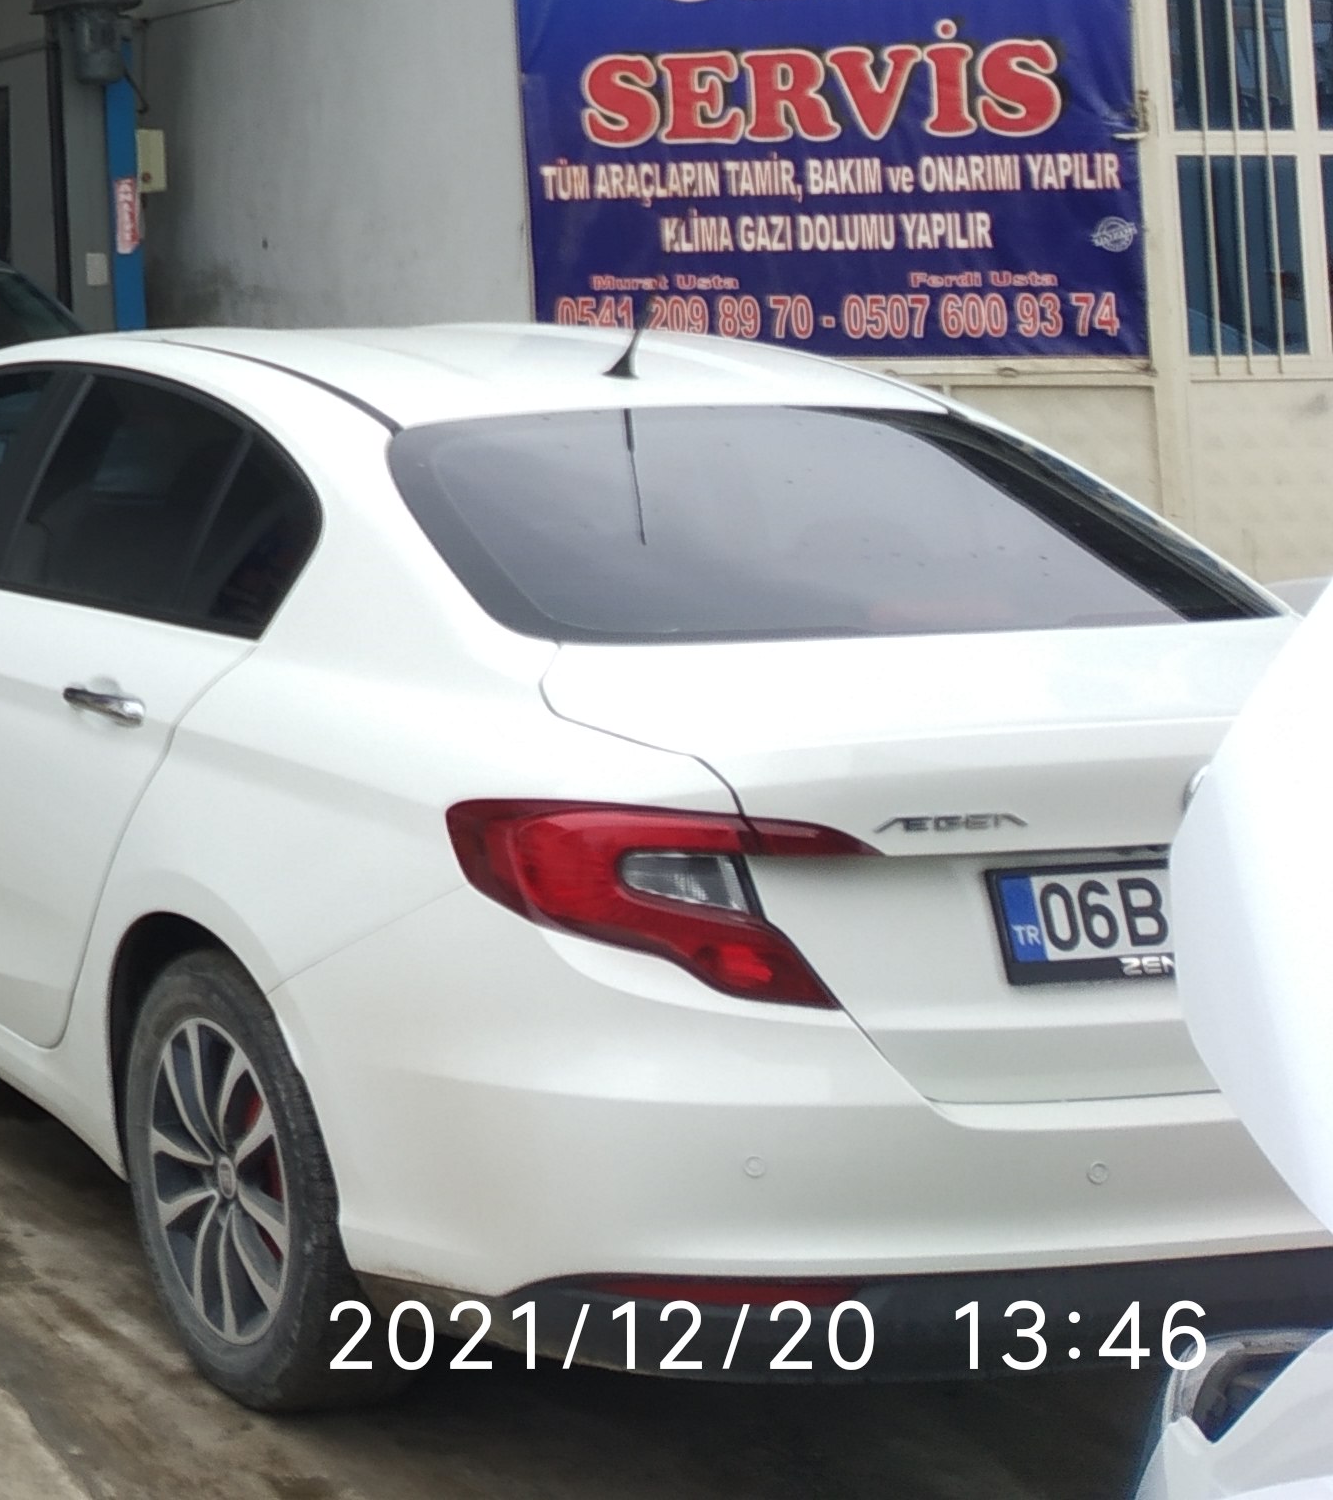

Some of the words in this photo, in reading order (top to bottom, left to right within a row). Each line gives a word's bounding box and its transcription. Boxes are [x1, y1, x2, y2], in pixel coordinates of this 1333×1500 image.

[581, 19, 1064, 148] SERVİS
[540, 155, 588, 201] TÜM
[595, 161, 720, 208] ARAÇLARIN
[725, 151, 803, 202] TAMİR,
[809, 157, 882, 195] BAKIM
[886, 165, 914, 192] ve
[921, 154, 1021, 192] ONARIMI
[1028, 152, 1121, 190] YAPILIR
[661, 209, 733, 254] KLİMA
[740, 215, 793, 251] GAZI
[799, 213, 896, 251] DOLUMU
[899, 211, 993, 249] YAPILIR
[591, 276, 669, 290] Murat
[676, 276, 739, 290] Usta
[910, 272, 982, 288] Ferdi
[991, 271, 1059, 287] Usta
[557, 296, 633, 328] 0541
[647, 296, 709, 335] 209
[718, 295, 760, 338] 89
[769, 294, 814, 339] 70
[844, 294, 927, 339] 0507
[941, 294, 1010, 339] 600
[1016, 293, 1063, 338] 93
[1074, 292, 1121, 337] 74
[1012, 924, 1042, 946] TR
